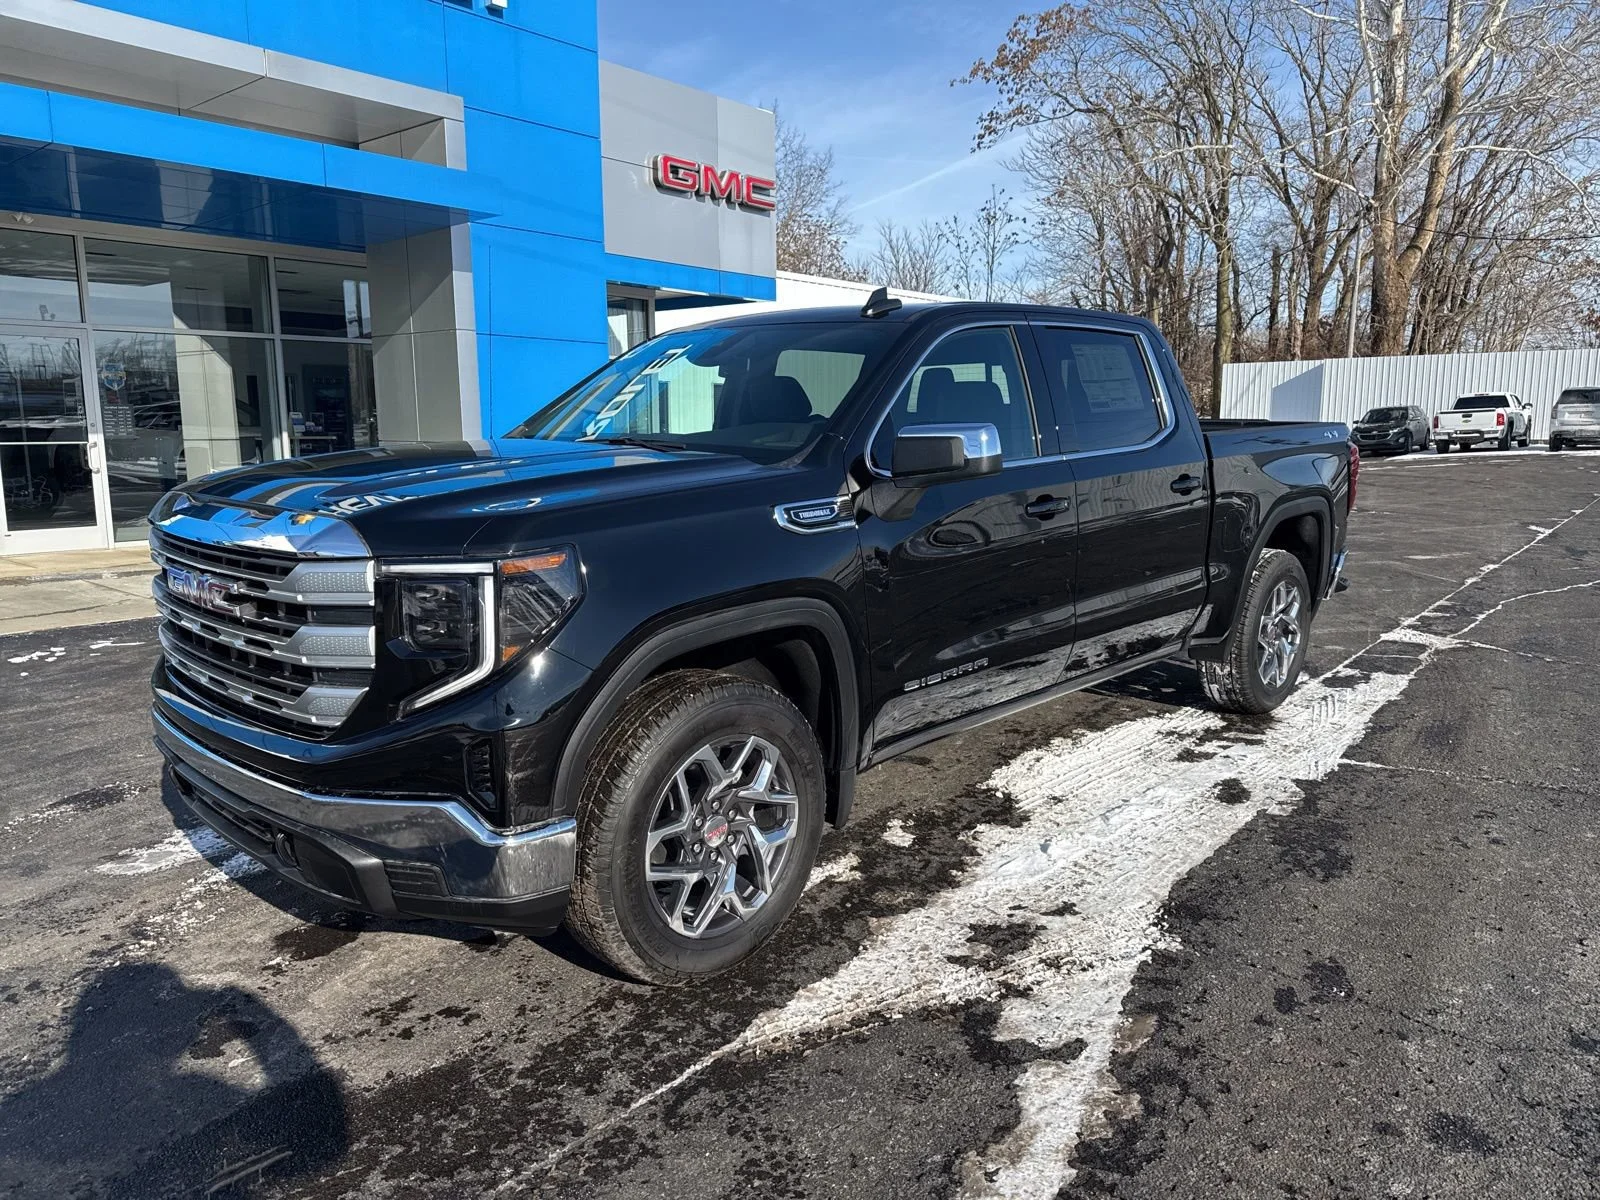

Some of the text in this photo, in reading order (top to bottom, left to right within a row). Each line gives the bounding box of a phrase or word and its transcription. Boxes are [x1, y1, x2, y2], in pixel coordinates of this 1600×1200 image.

[653, 153, 776, 212] GMC
[167, 567, 242, 617] GMC
[903, 657, 989, 691] SIERRA
